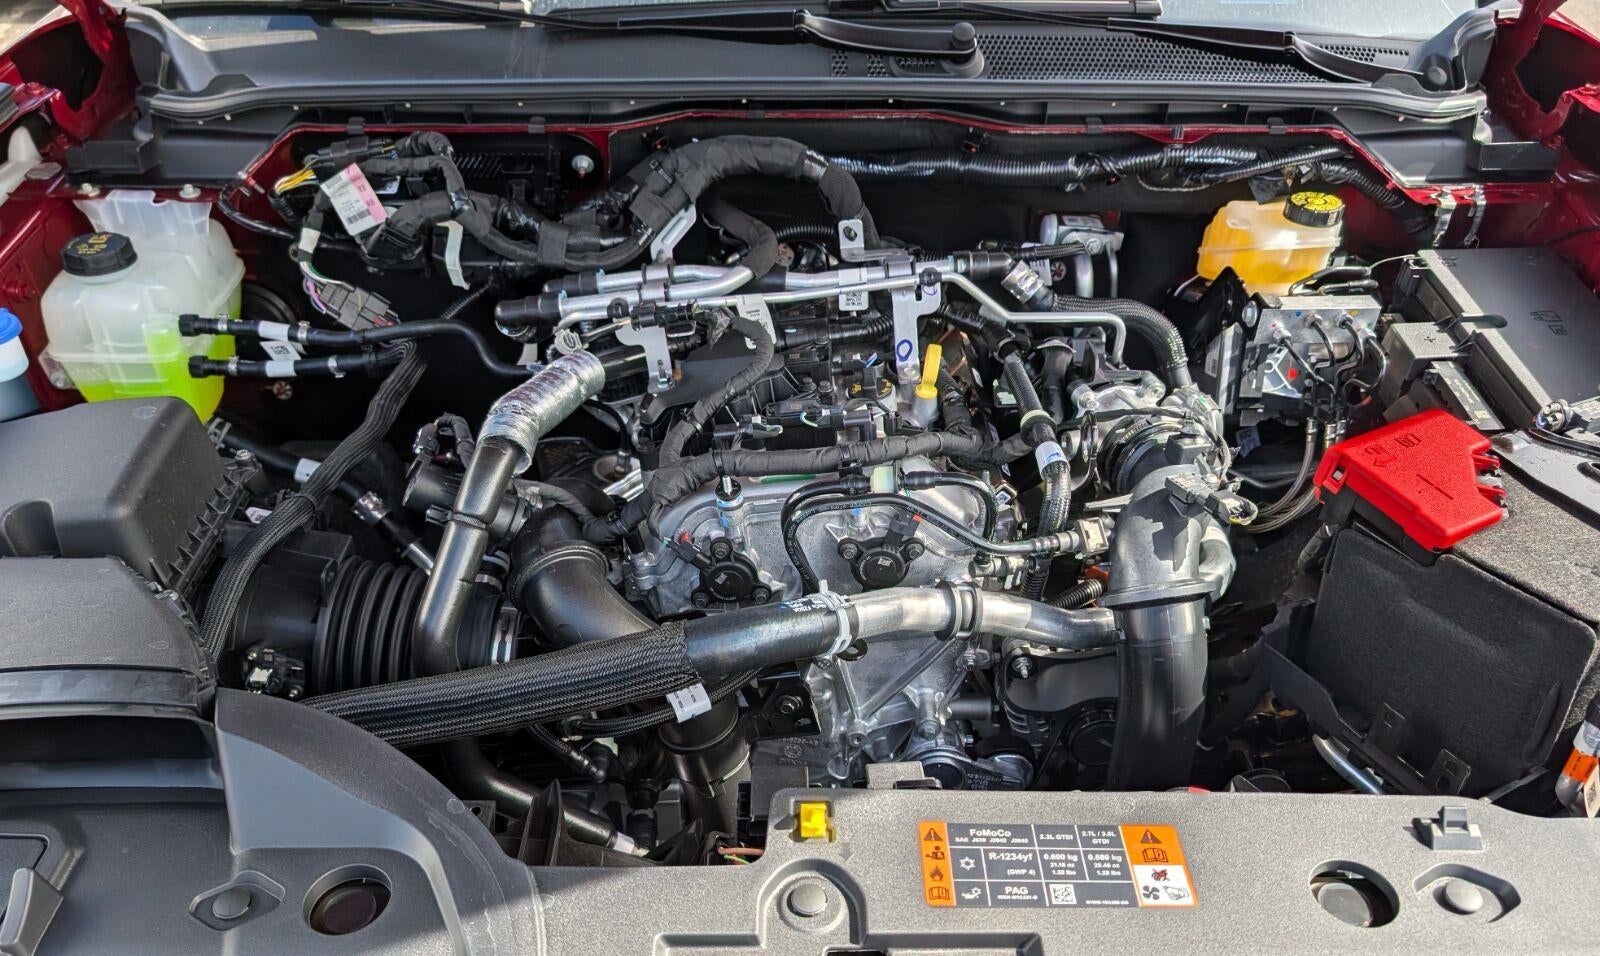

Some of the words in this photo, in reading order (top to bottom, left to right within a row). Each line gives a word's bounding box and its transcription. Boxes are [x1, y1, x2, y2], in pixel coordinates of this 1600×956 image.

[969, 829, 1011, 837] FoMoCo
[988, 852, 1033, 862] R-1234yf
[1067, 853, 1078, 861] kg
[1111, 854, 1122, 862] kg
[1007, 868, 1027, 876] (GWP
[1028, 868, 1036, 876] 4)
[1004, 886, 1029, 895] PAG
